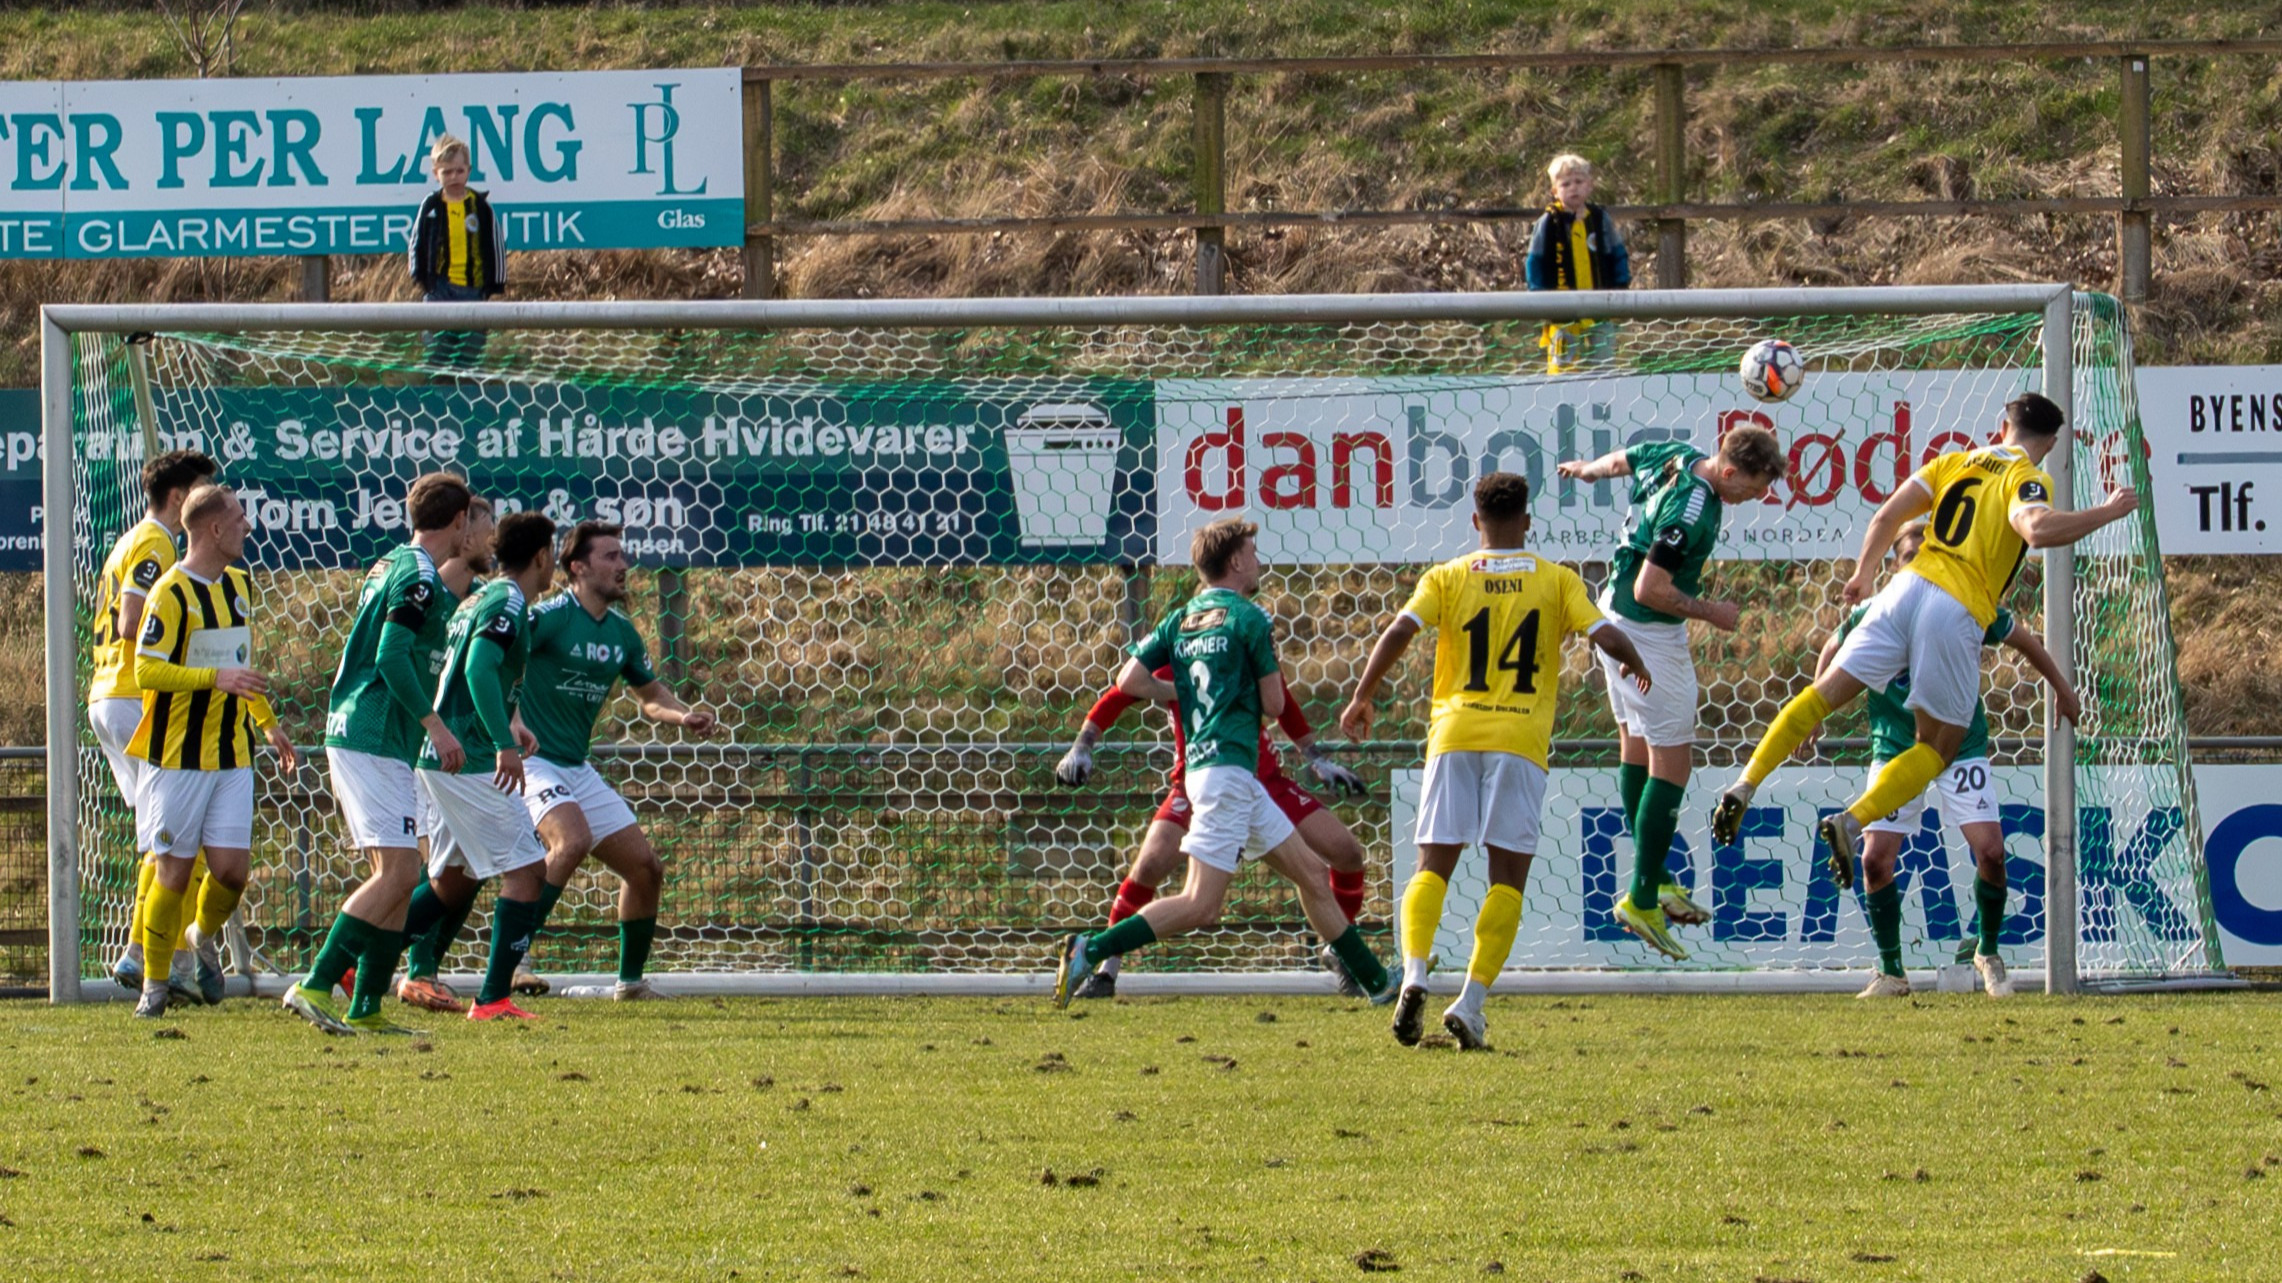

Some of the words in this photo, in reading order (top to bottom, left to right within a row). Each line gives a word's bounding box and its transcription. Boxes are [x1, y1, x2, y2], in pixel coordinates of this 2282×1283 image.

[0, 112, 130, 191] ER
[155, 109, 329, 189] PER
[354, 101, 583, 185] LANG
[657, 209, 706, 229] Glas
[223, 420, 258, 460] &
[275, 418, 461, 461] Service
[477, 418, 523, 459] af
[539, 413, 686, 458] Hårde
[704, 415, 976, 457] Hvidevarer
[236, 488, 337, 530] Tom
[541, 488, 579, 528] &
[594, 496, 684, 528] søn
[748, 515, 792, 535] Ring
[799, 514, 829, 531] Tlf.
[835, 515, 859, 531] 21
[869, 515, 897, 532] 48
[936, 515, 960, 531] 21
[1933, 477, 1984, 547] 6
[2189, 481, 2267, 532] Tlf.
[1743, 528, 1846, 543] NORDEA
[1484, 579, 1523, 594] OSENI
[1462, 607, 1540, 694] 14
[1953, 765, 1986, 794] 20
